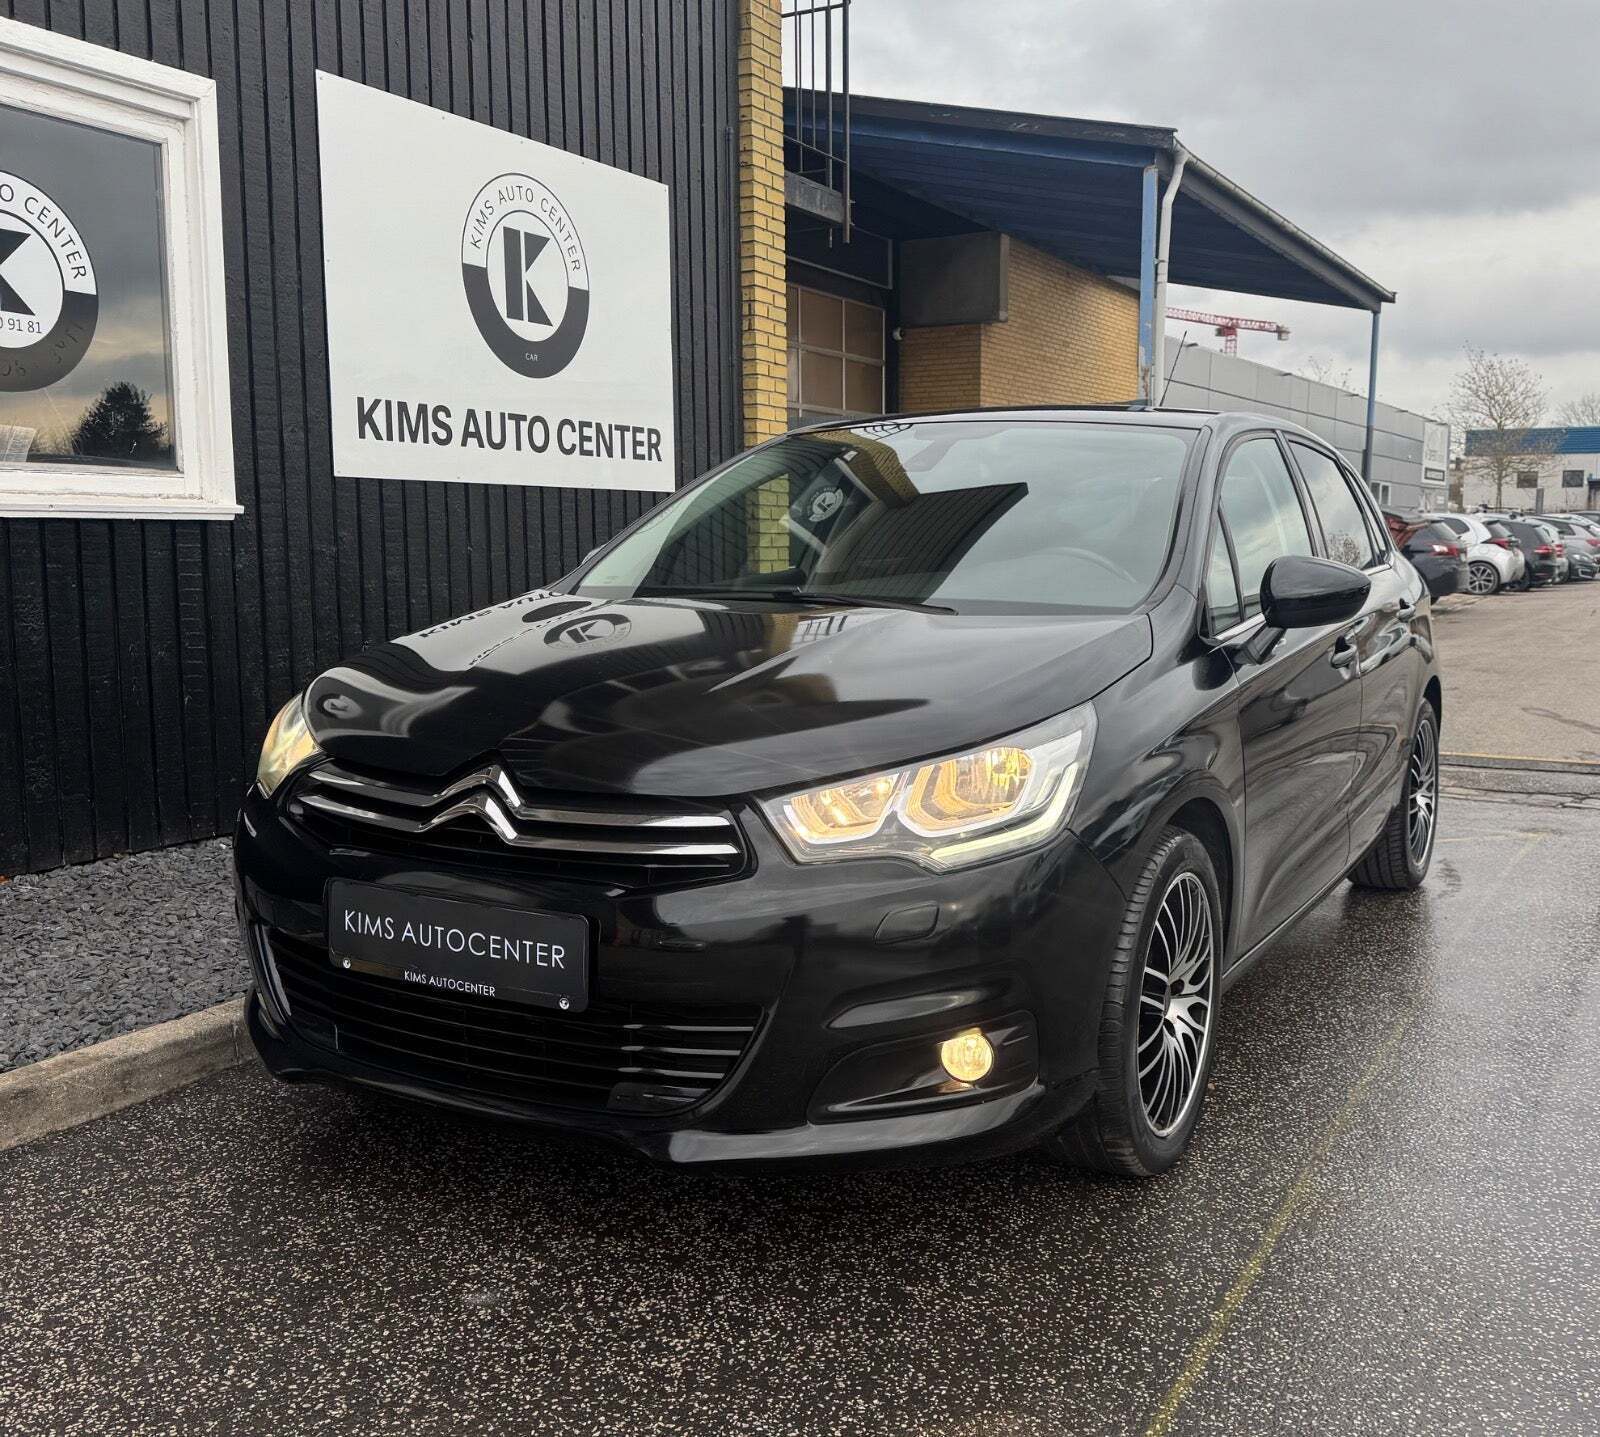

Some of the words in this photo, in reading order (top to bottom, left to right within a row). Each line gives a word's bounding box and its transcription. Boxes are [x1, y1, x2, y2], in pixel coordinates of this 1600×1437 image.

[24, 196, 87, 279] CENTER
[470, 200, 494, 249] KIMS
[498, 185, 534, 204] AUTO
[540, 198, 581, 271] CENTER
[7, 317, 23, 332] 91
[27, 320, 42, 334] 81
[525, 352, 538, 362] CAR
[356, 396, 453, 446] KIMS
[460, 408, 550, 453] AUTO
[556, 418, 662, 462] CENTER
[345, 909, 394, 940] KIMS
[401, 921, 565, 969] AUTOCENTER
[404, 970, 427, 985] KIMS
[428, 977, 496, 998] AUTOCENTER
